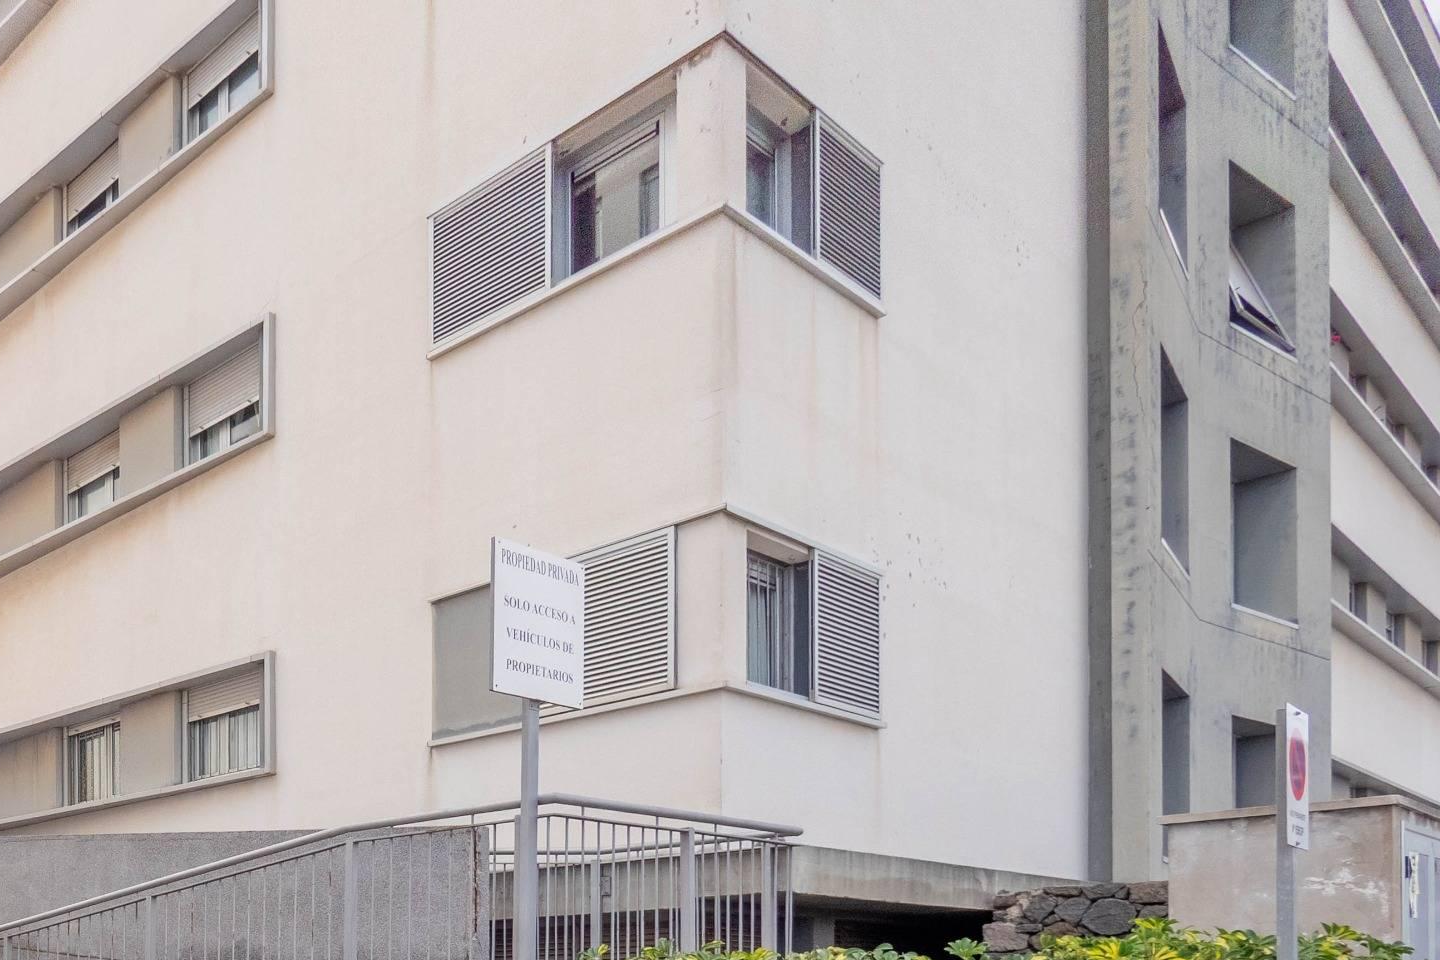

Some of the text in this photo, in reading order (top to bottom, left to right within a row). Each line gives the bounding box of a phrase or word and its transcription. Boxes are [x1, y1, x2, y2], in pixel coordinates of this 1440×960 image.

[501, 548, 580, 587] PROPIEDAD PRIVADA
[504, 594, 576, 625] SOLO ACCESO A
[506, 627, 574, 655] VEHÍCULOS DE
[506, 658, 574, 684] PROPIETARIOS
